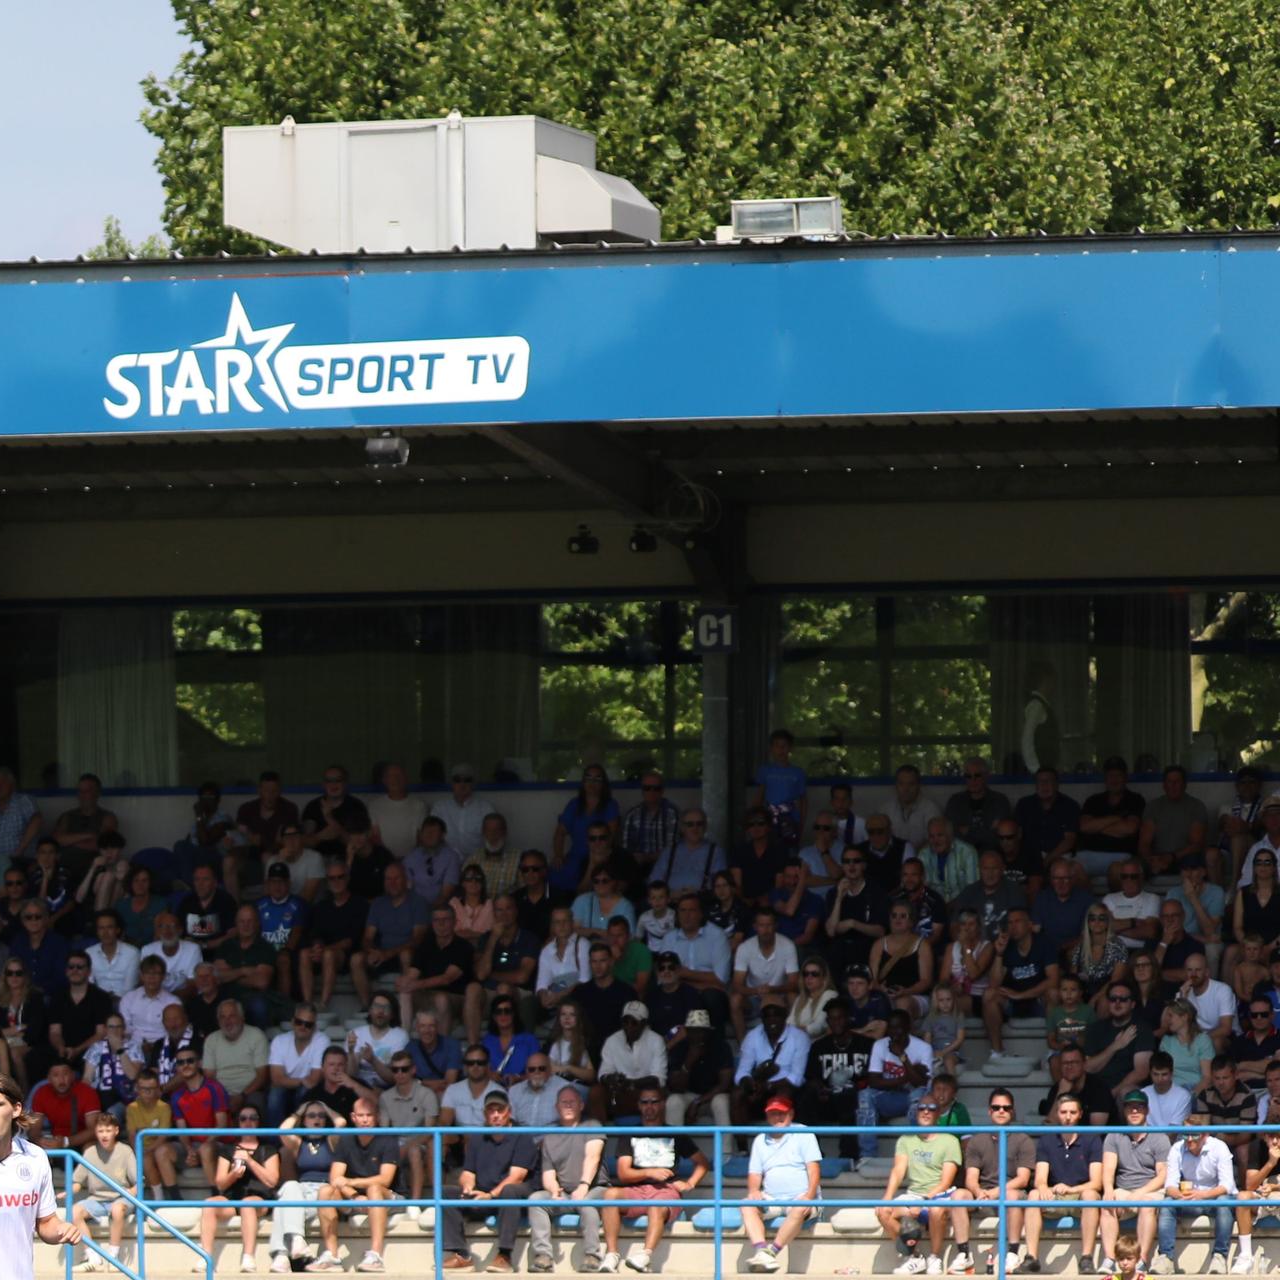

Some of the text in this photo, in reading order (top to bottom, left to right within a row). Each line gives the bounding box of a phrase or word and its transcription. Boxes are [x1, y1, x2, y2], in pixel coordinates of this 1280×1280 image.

[103, 348, 516, 419] STAR SPORT TV
[698, 613, 732, 647] C1
